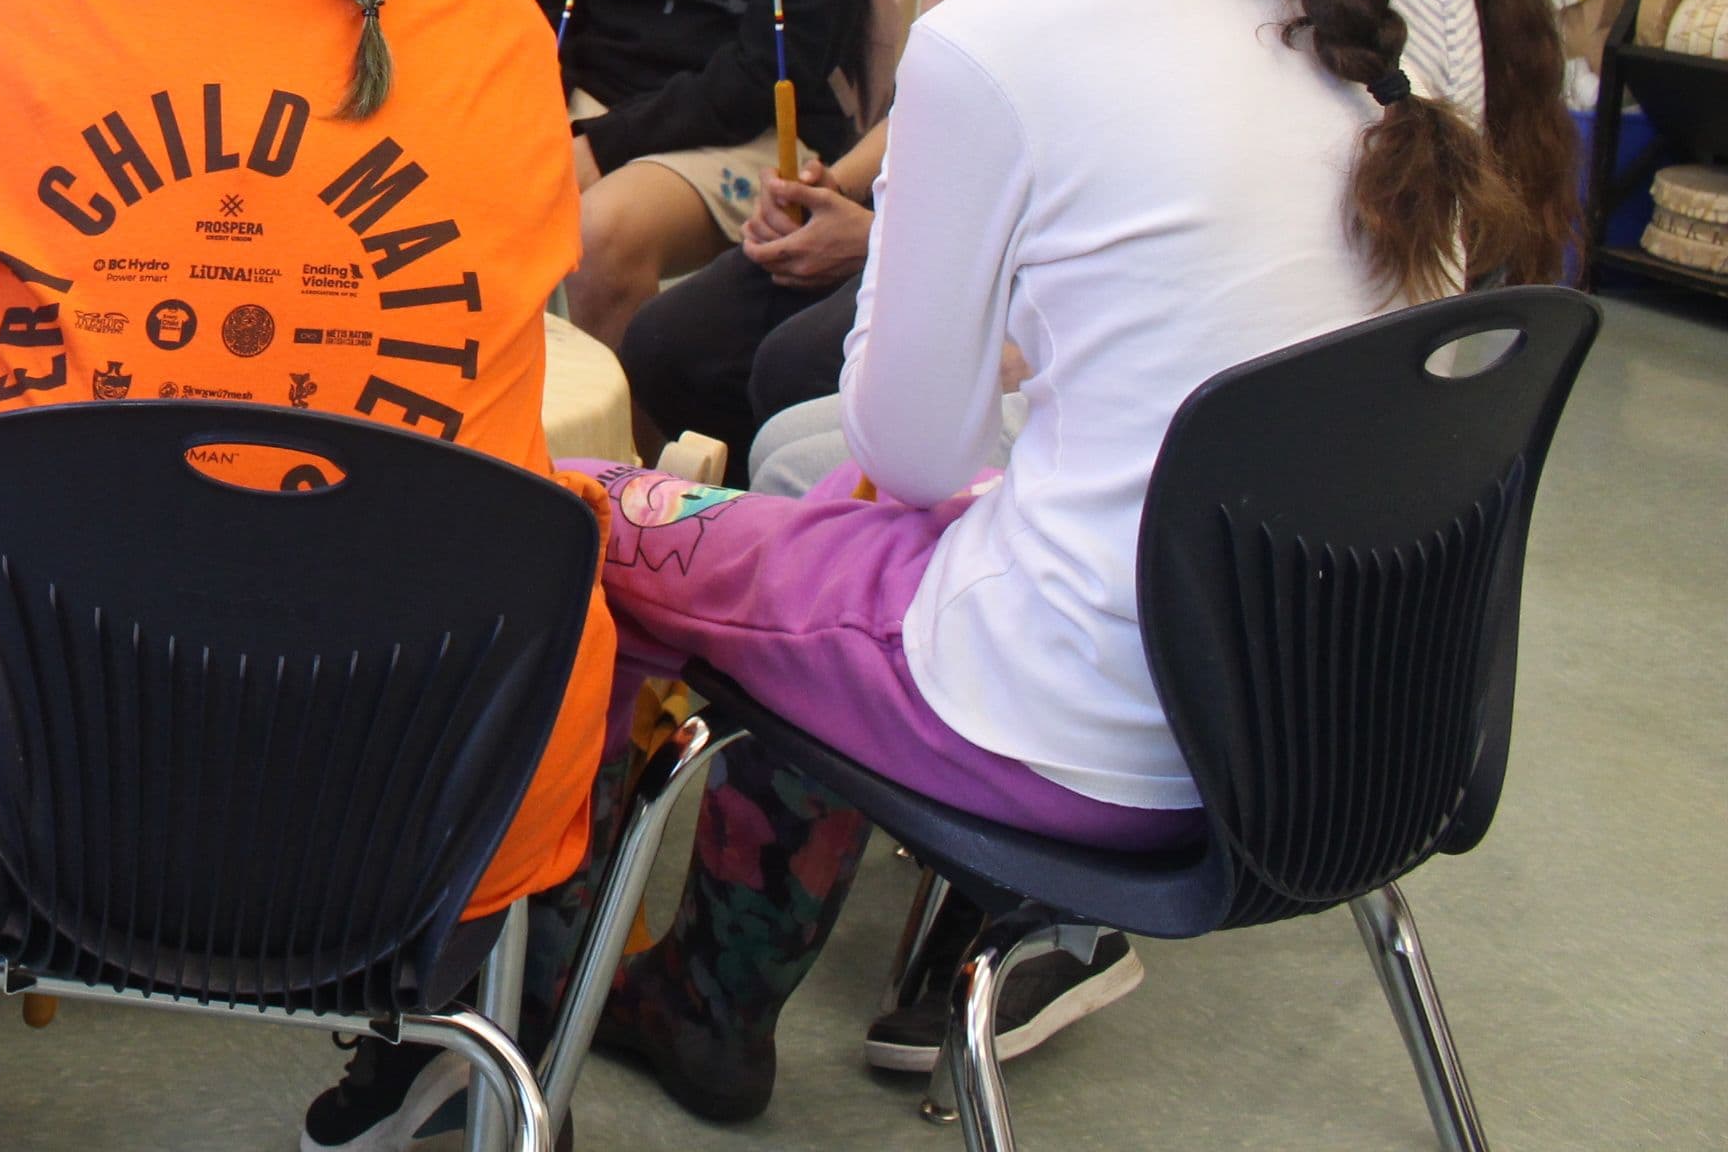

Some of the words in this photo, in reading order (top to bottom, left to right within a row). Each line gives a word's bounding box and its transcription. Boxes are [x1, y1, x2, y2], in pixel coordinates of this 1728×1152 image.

[195, 221, 264, 236] PROSPERA
[36, 83, 311, 237] CHILD
[318, 136, 482, 444] MATTE
[108, 259, 127, 270] BC
[128, 259, 170, 273] Hydro
[106, 273, 136, 282] Power
[138, 274, 168, 283] smart
[253, 268, 282, 276] LOCAL
[302, 264, 348, 279] Ending
[301, 276, 359, 289] Violence
